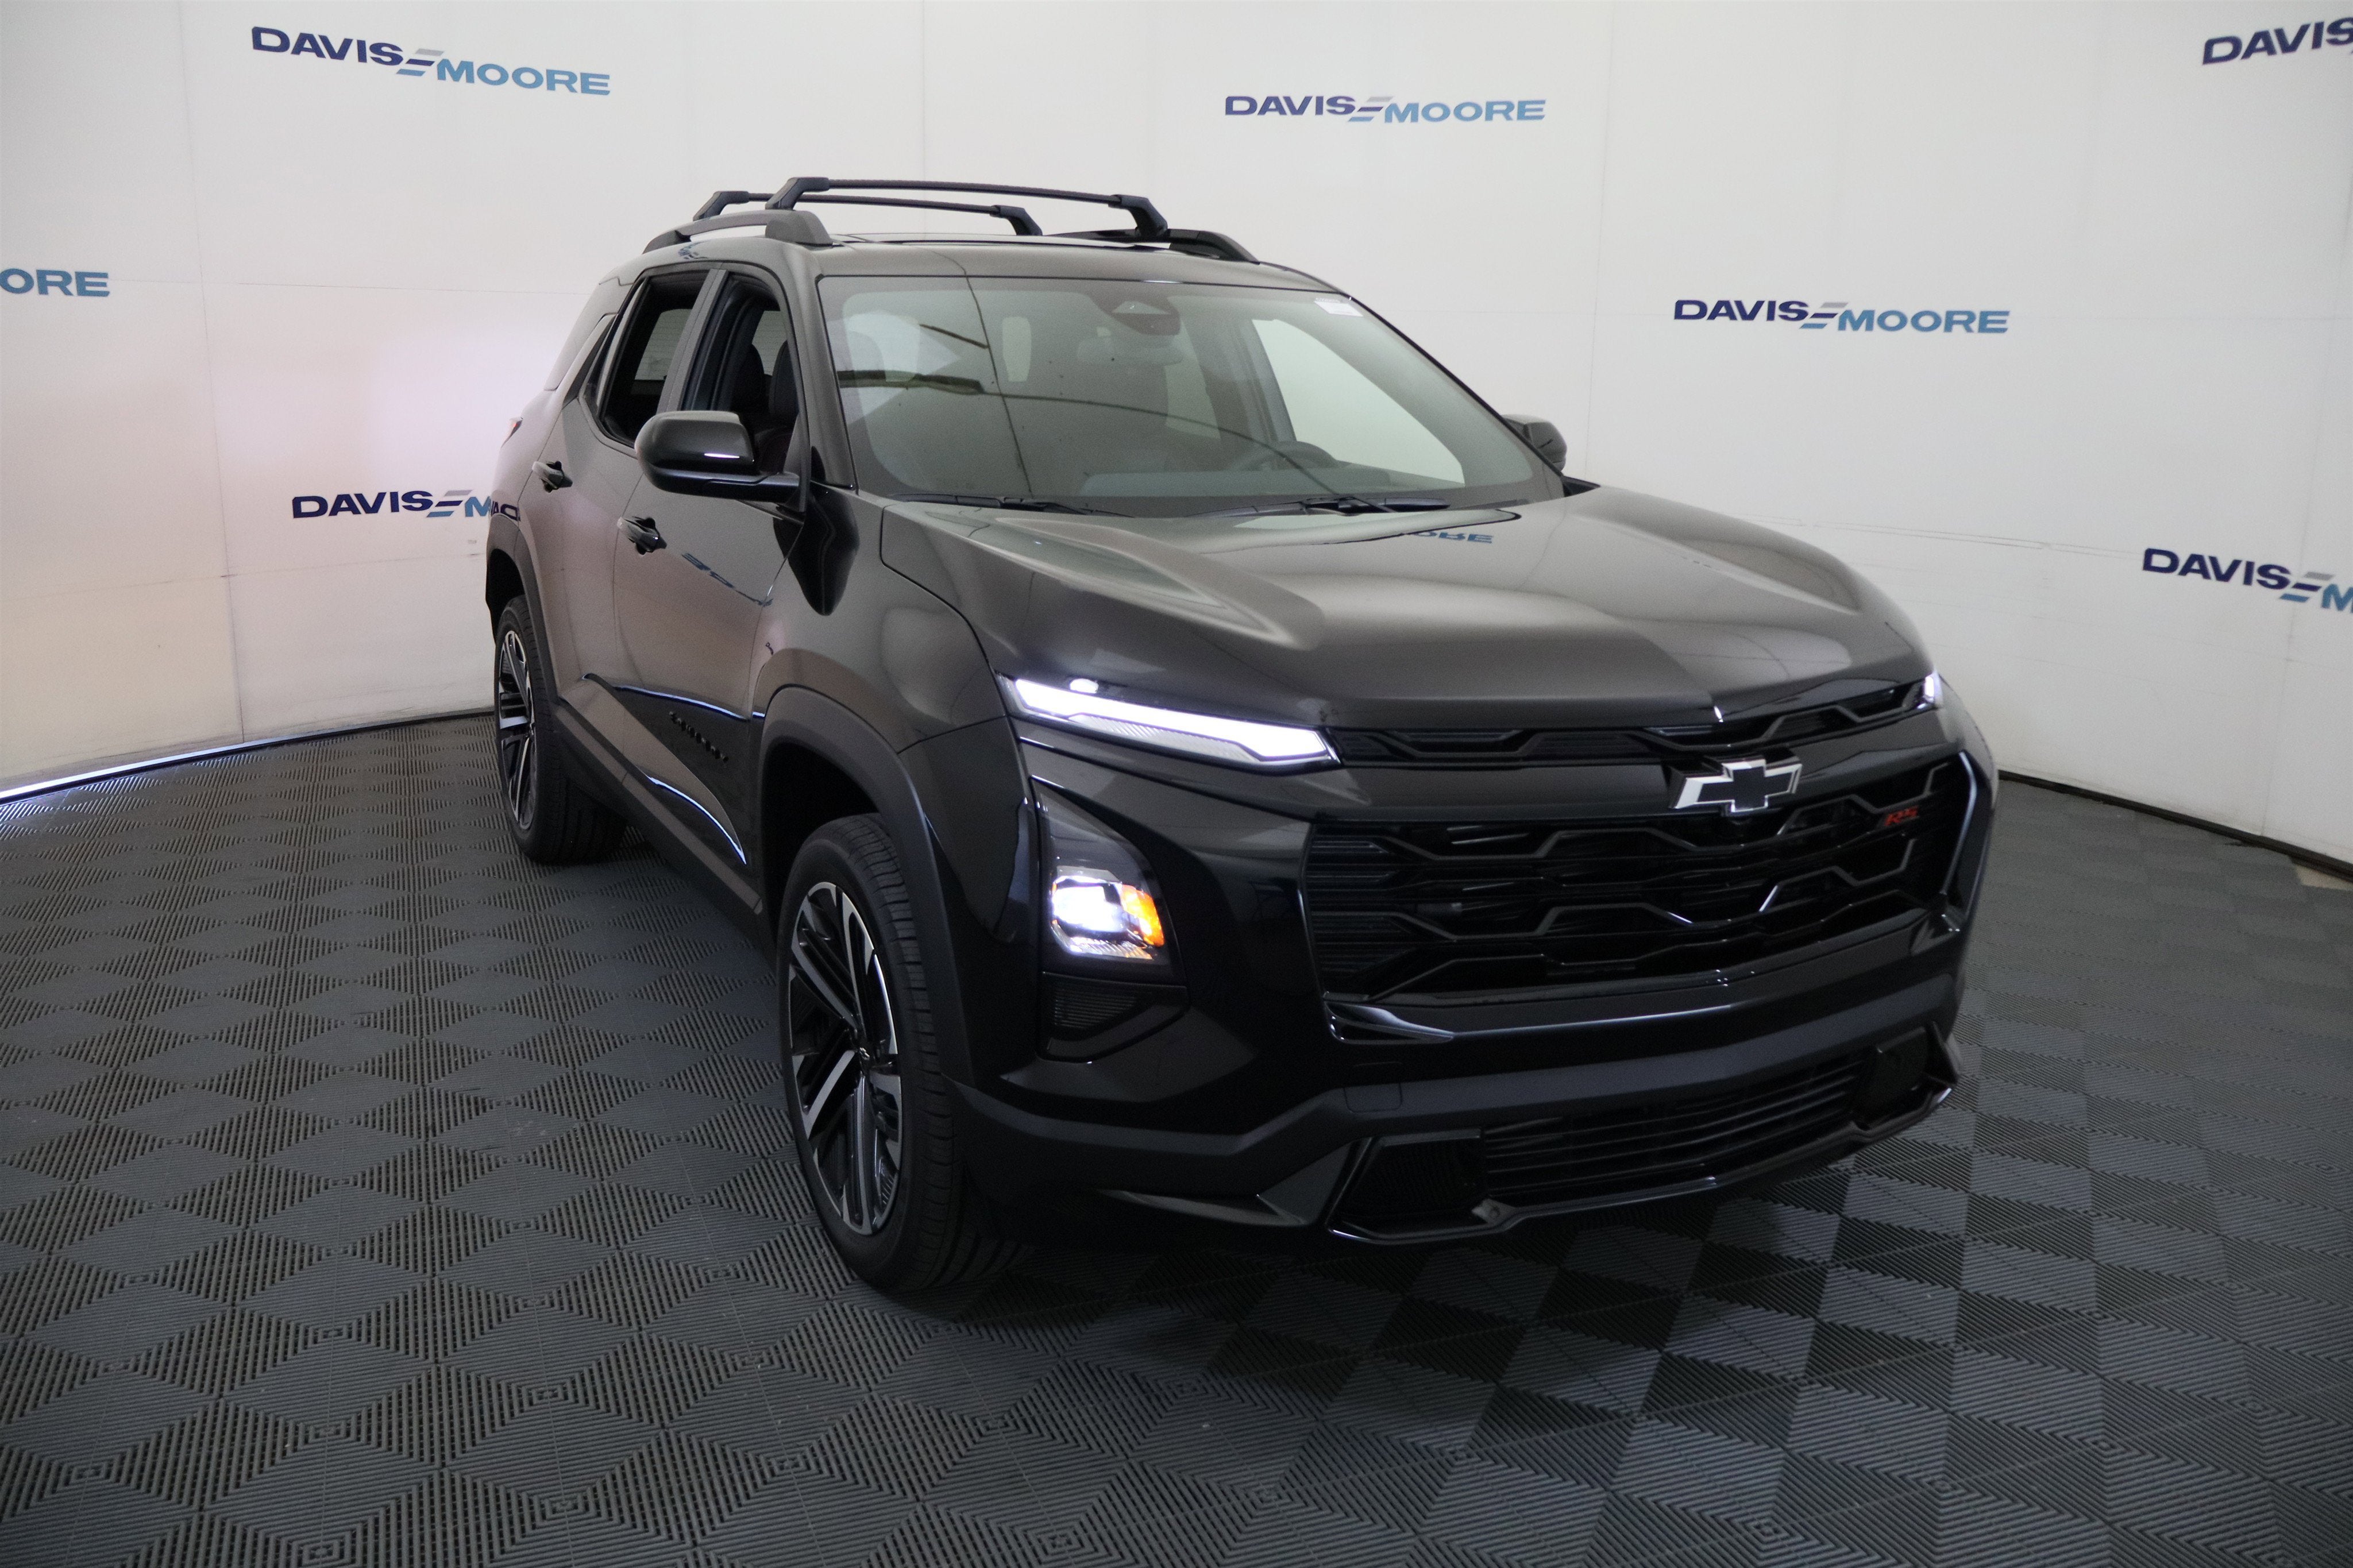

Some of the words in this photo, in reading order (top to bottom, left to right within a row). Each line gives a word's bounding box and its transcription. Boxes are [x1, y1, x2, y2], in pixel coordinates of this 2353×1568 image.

[2202, 16, 2353, 65] DAVIS
[252, 26, 403, 65] DAVIS
[437, 59, 610, 95] MOORE
[1225, 96, 1356, 115] DAVIS
[1385, 100, 1545, 123] MOORE
[0, 268, 110, 297] ORE
[1674, 300, 1808, 322] DAVIS
[1838, 310, 2009, 333] MOORE
[292, 491, 433, 519] DAVIS
[2142, 548, 2291, 590] DAVIS
